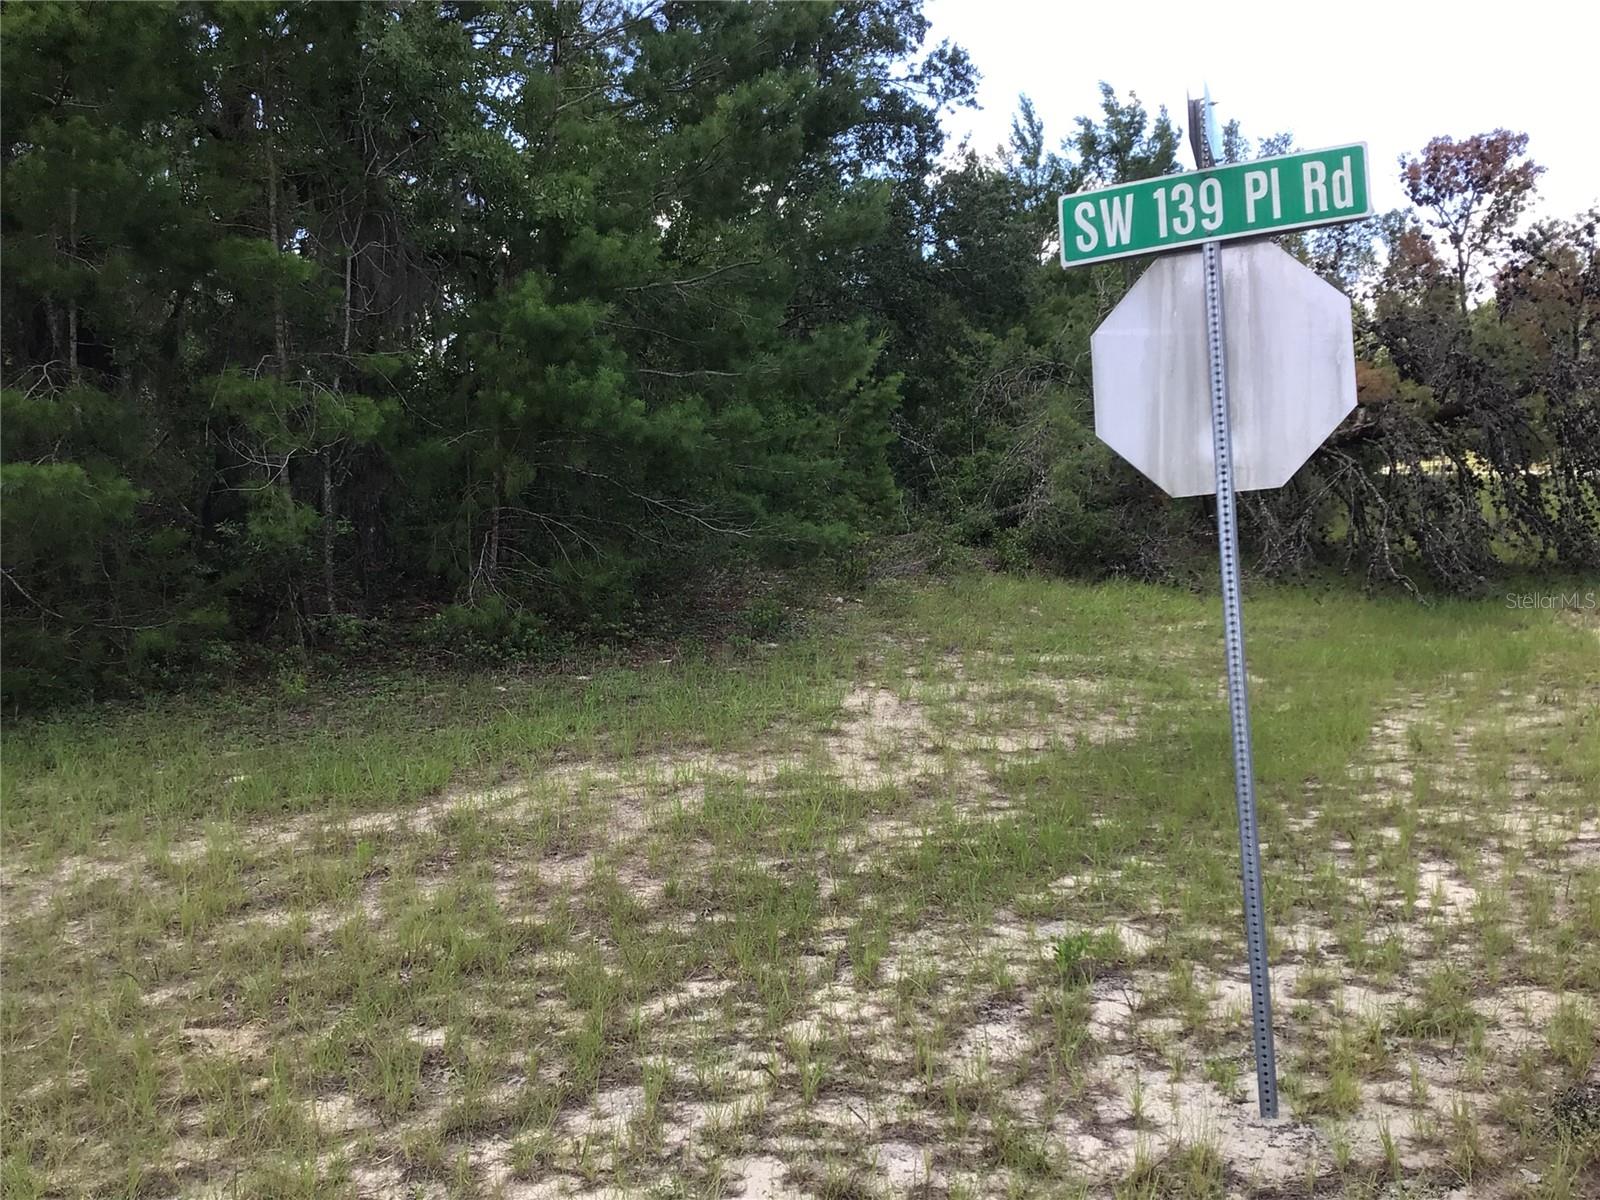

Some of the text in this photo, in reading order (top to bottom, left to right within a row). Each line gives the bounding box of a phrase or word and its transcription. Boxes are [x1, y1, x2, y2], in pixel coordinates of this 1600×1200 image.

[1074, 155, 1354, 252] SW 139 Pl Rd
